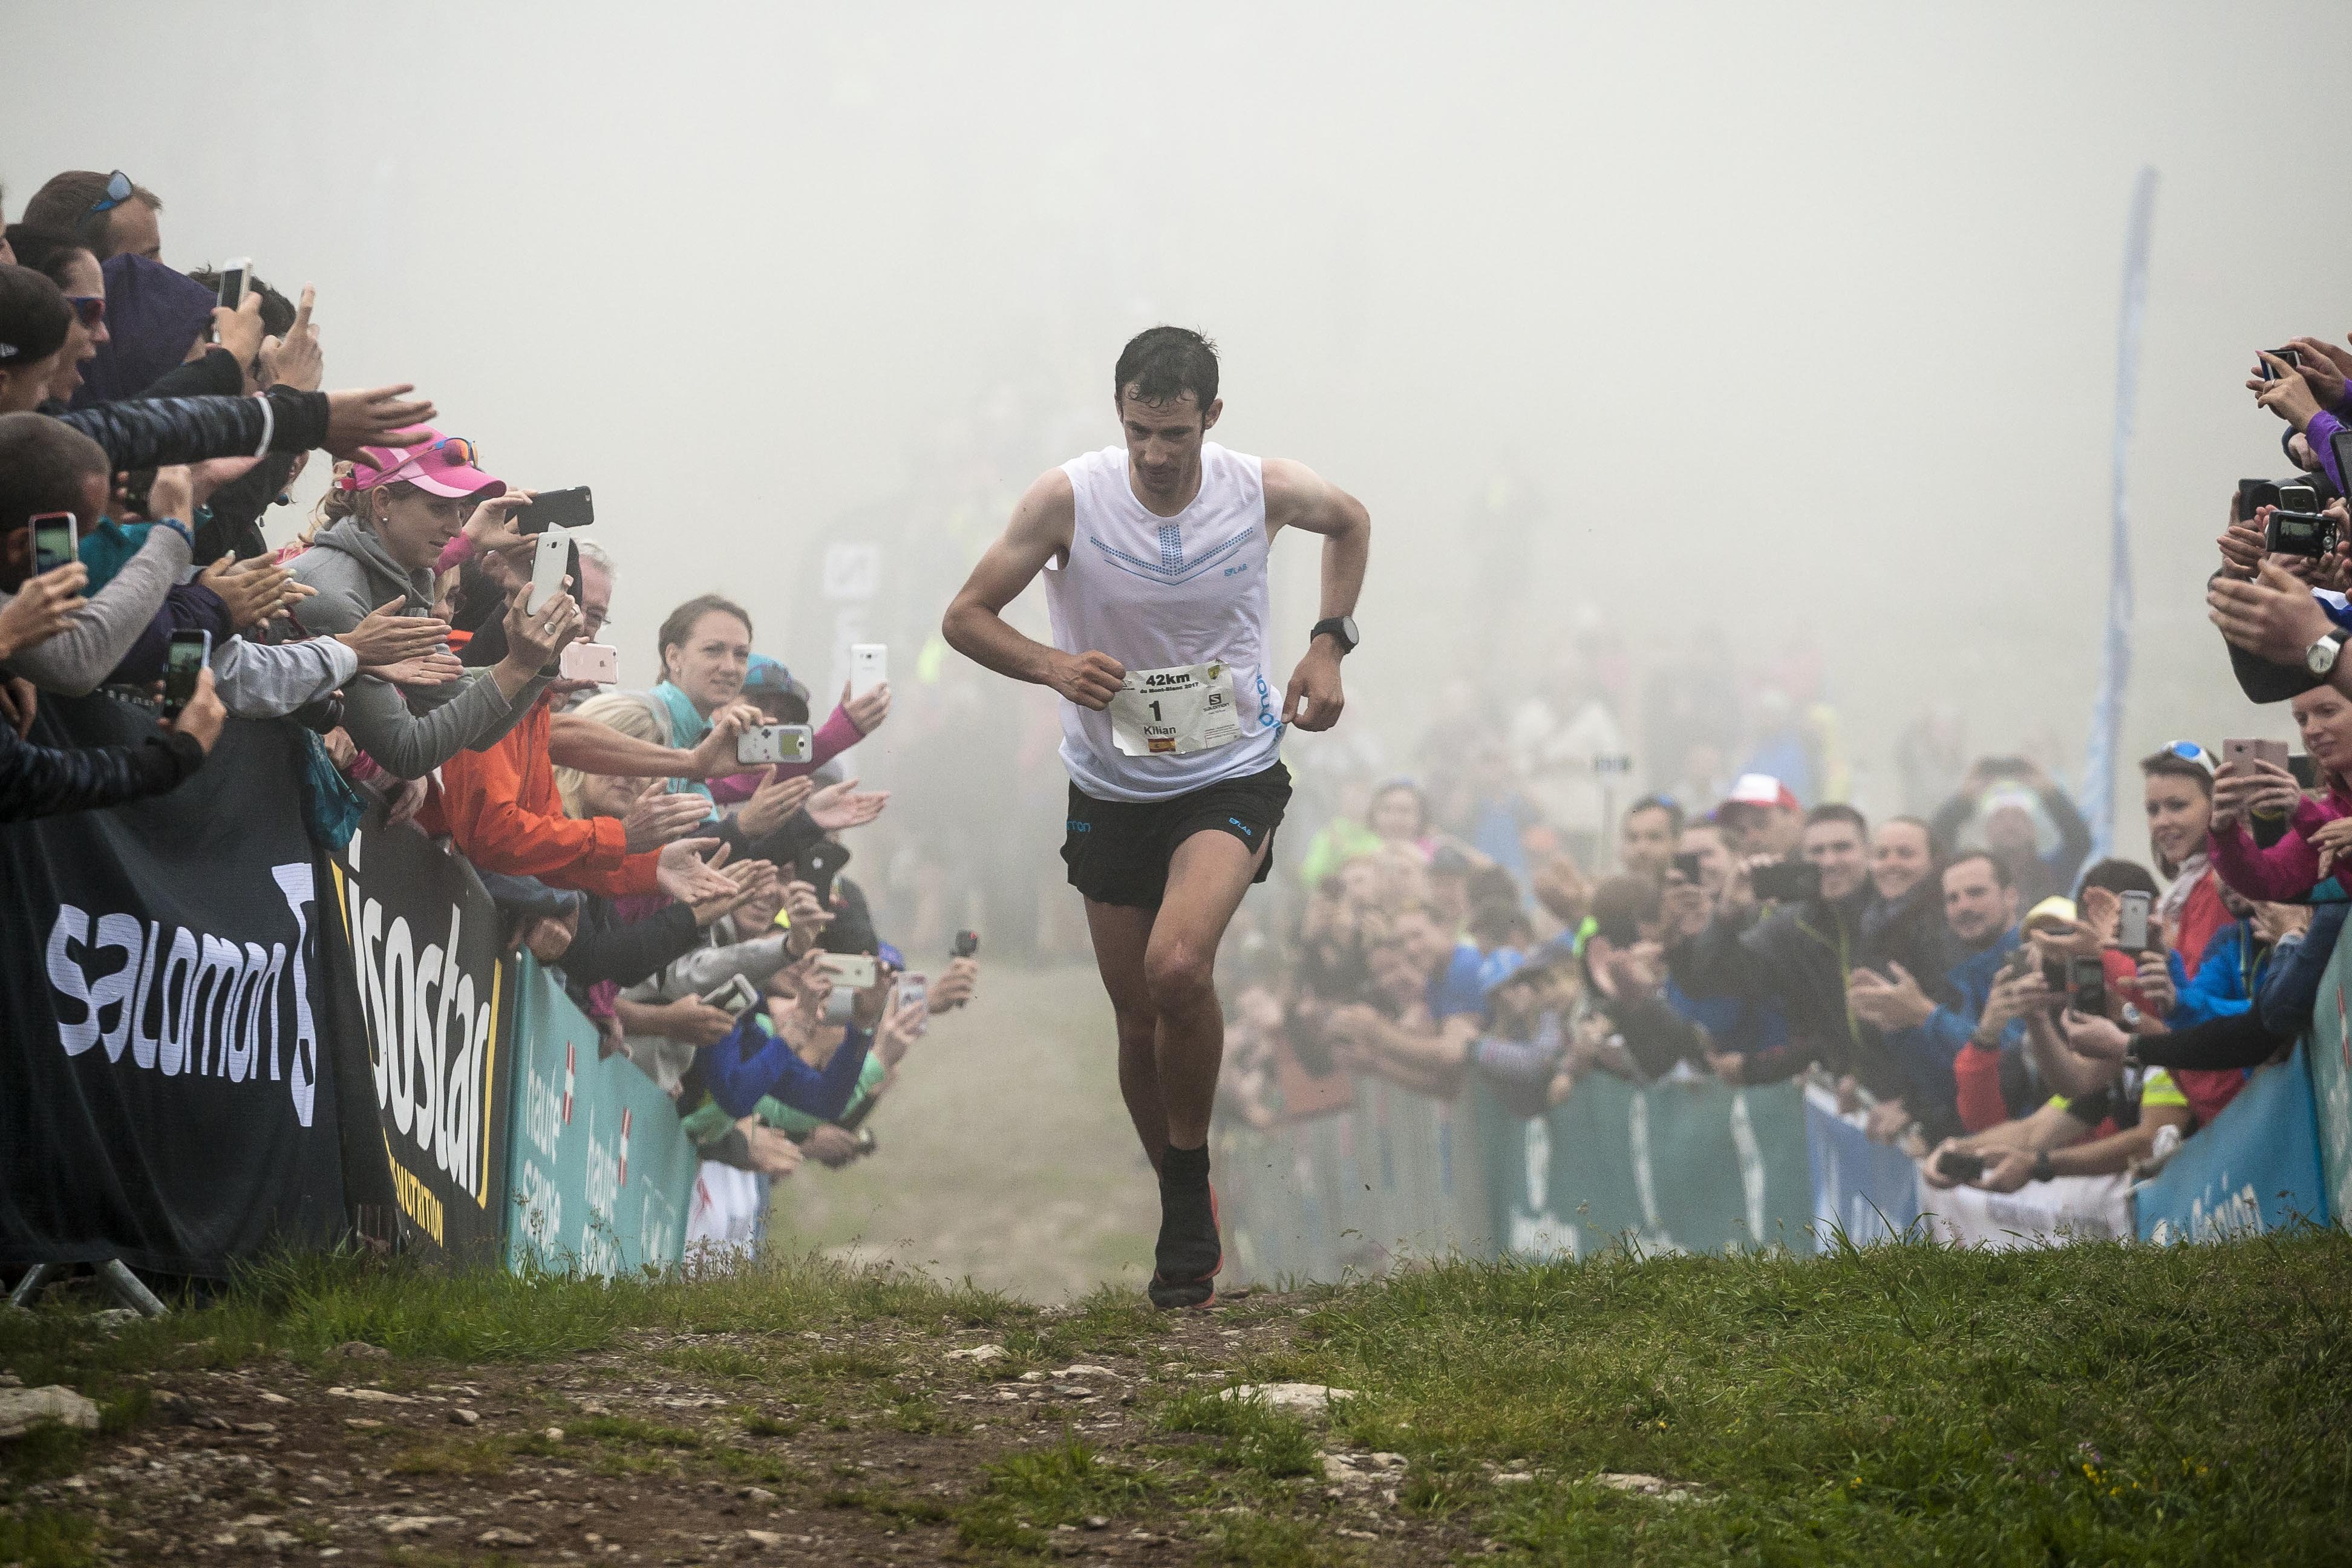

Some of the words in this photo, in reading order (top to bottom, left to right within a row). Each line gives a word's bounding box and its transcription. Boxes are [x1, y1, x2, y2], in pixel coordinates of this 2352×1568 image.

[1146, 673, 1191, 686] 42km
[1149, 700, 1162, 722] 1
[1143, 725, 1177, 736] Kilian
[45, 904, 287, 1082] salomon
[348, 827, 491, 1200] isostar
